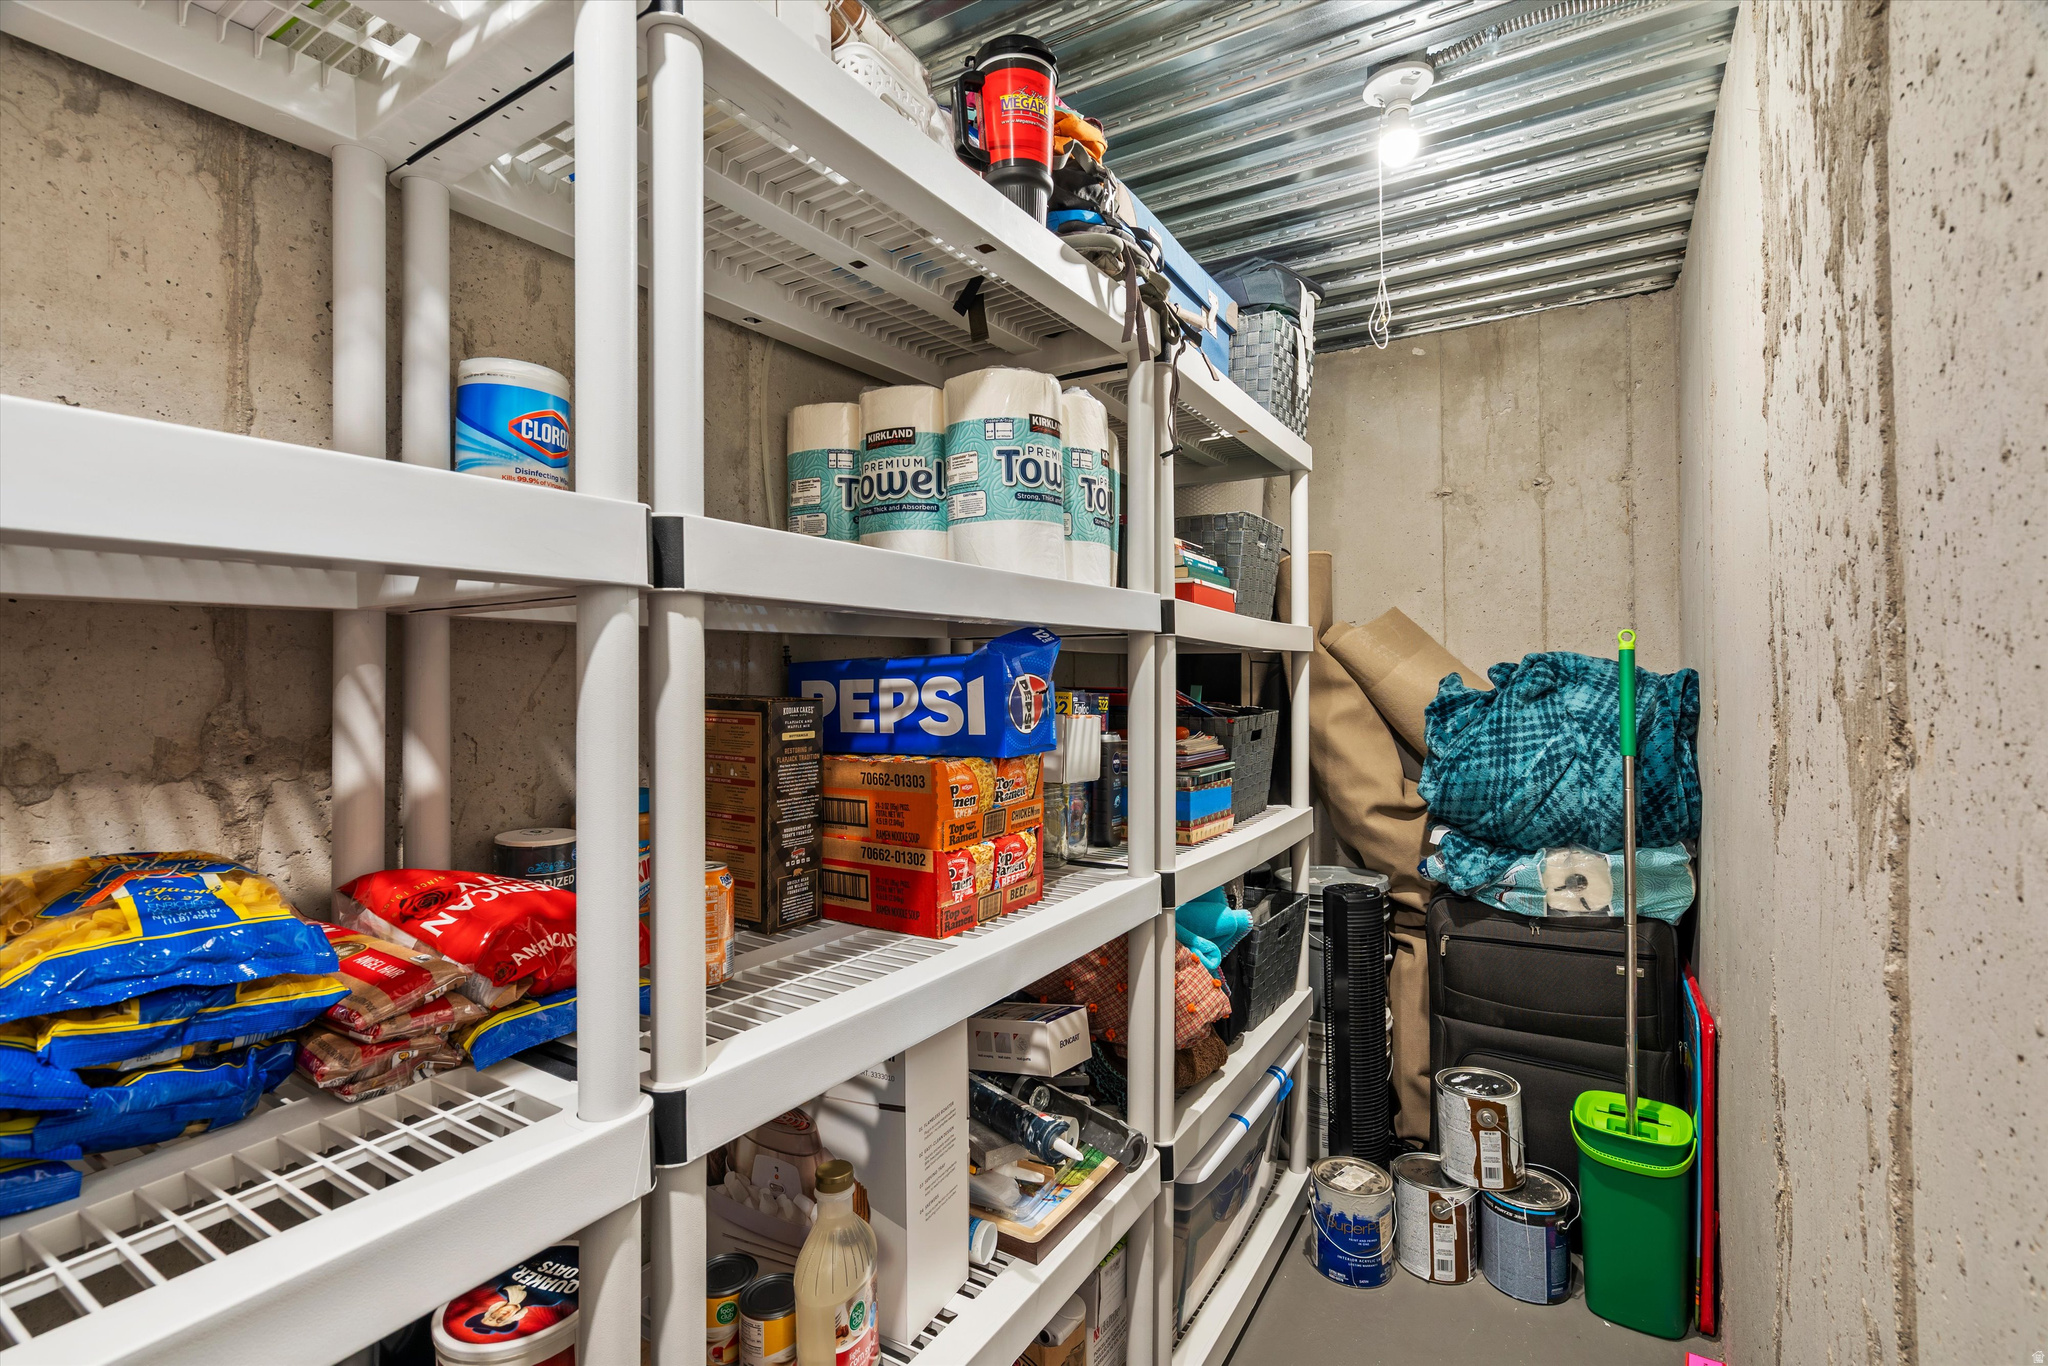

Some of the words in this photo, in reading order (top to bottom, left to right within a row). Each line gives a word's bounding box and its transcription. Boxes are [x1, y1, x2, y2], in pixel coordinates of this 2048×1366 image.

[868, 429, 914, 443] KIRKLAND
[864, 458, 923, 473] PREMIUM
[515, 467, 559, 482] Disinfecting
[517, 475, 539, 485] 99.9%
[1017, 493, 1040, 501] Strong,
[874, 504, 888, 513] Thick
[901, 504, 938, 512] Absorbent
[1032, 628, 1050, 644] 12
[799, 706, 815, 714] CAKES
[801, 675, 987, 737] PEPSI
[1019, 680, 1032, 730] PEPSI
[776, 755, 798, 764] FLAPJACK
[798, 753, 820, 761] TRADITION
[860, 772, 926, 788] 70662-01303
[996, 777, 1015, 792] Top
[994, 786, 1027, 803] Ramen
[1012, 806, 1035, 821] CHICKEN
[876, 829, 891, 840] RAMEN
[892, 831, 908, 843] NOODLE
[908, 832, 920, 844] SOUP
[949, 824, 965, 835] Top
[949, 832, 979, 846] Ramen
[860, 847, 926, 866] 70662-01302
[414, 876, 446, 891] SINCE
[1010, 885, 1028, 900] BEEF
[876, 904, 891, 915] RAMEN
[892, 906, 908, 918] NOODLE
[908, 910, 920, 920] SOUP
[944, 909, 960, 921] Top
[163, 915, 190, 925] (1LB)
[944, 914, 975, 932] Ramen
[352, 955, 383, 972] ANGEL
[378, 963, 406, 979] HAIR
[1337, 1255, 1358, 1263] INTERIOR
[537, 1260, 579, 1280] OATS
[720, 1306, 735, 1315] food
[720, 1312, 734, 1322] club
[852, 1304, 864, 1319] food
[853, 1314, 863, 1327] club
